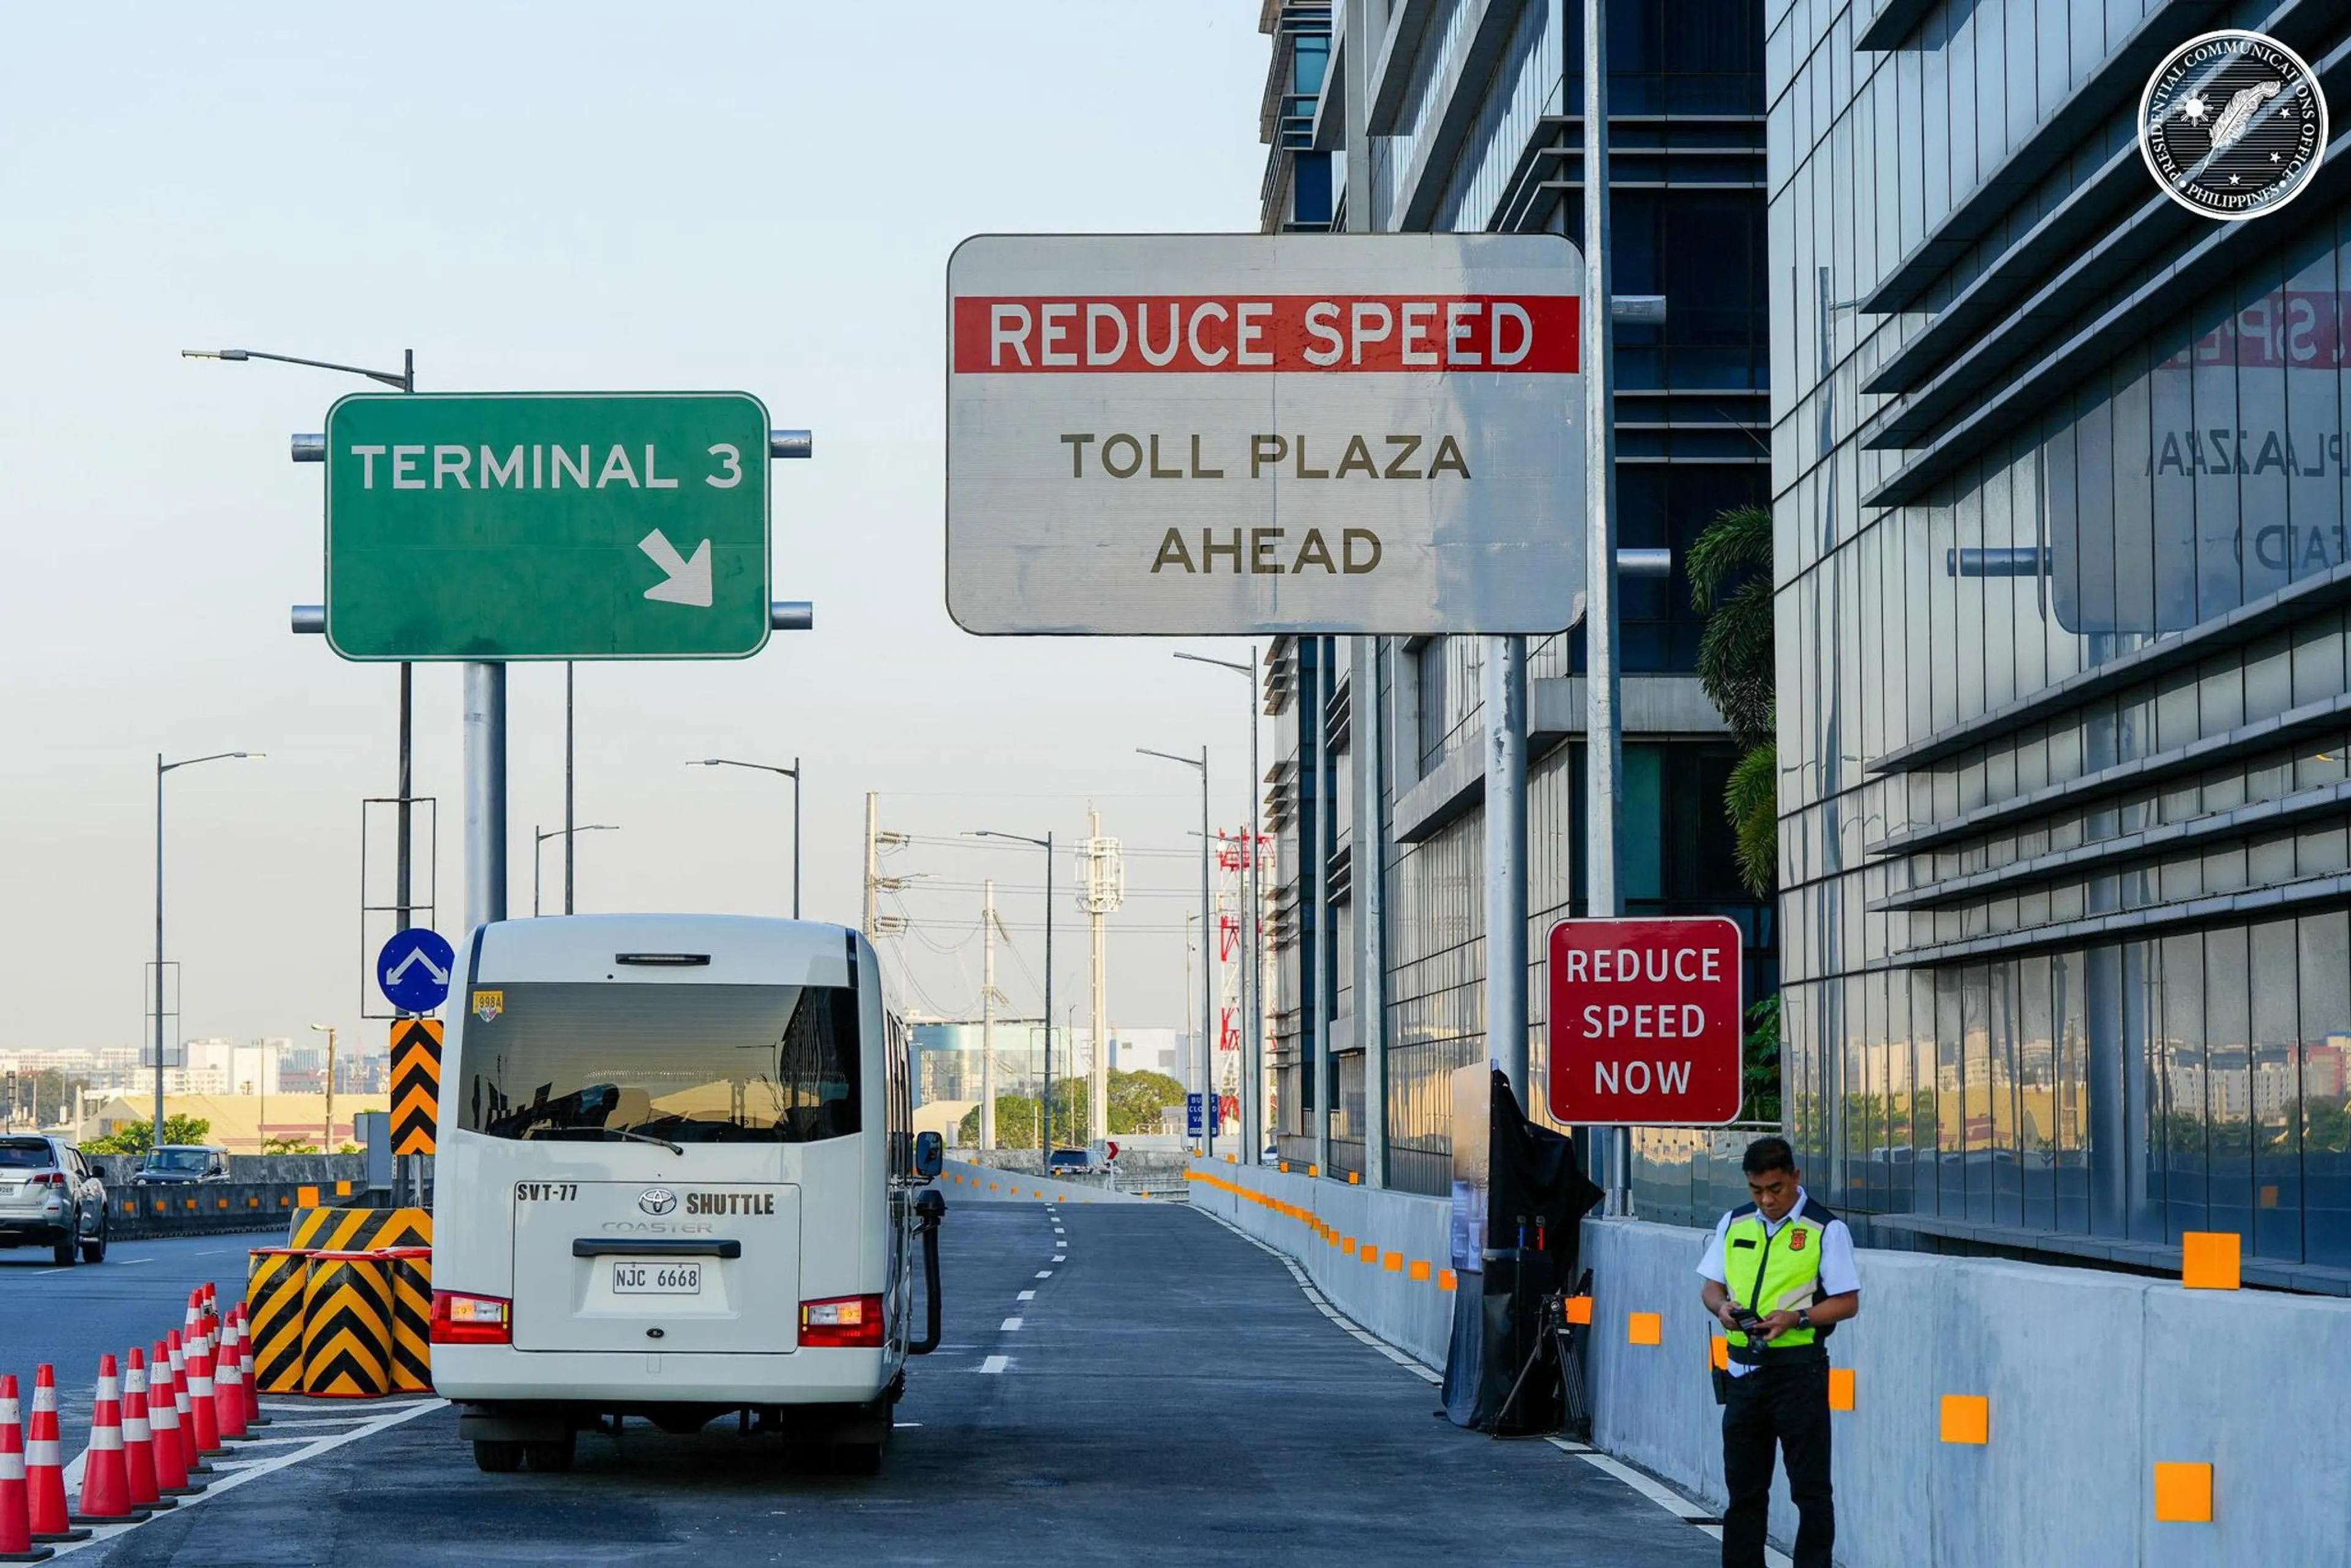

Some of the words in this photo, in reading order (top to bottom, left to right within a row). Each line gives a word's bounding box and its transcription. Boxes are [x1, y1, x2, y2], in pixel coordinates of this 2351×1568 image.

[991, 302, 1273, 366] REDUCE
[1303, 302, 1533, 366] SPEED
[351, 444, 678, 489] TERMINAL
[705, 443, 743, 489] 3
[1060, 432, 1224, 479] TOLL
[1251, 434, 1471, 479] PLAZA
[1150, 527, 1382, 574] AHEAD
[1567, 948, 1720, 982] REDUCE
[1583, 1004, 1705, 1038] SPEED
[1595, 1060, 1692, 1095] NOW
[517, 1184, 578, 1201] SVT-77
[686, 1193, 774, 1215] SHUTTLE
[601, 1222, 713, 1234] COASTER
[616, 1269, 646, 1287] NJC
[658, 1269, 697, 1287] 6668
